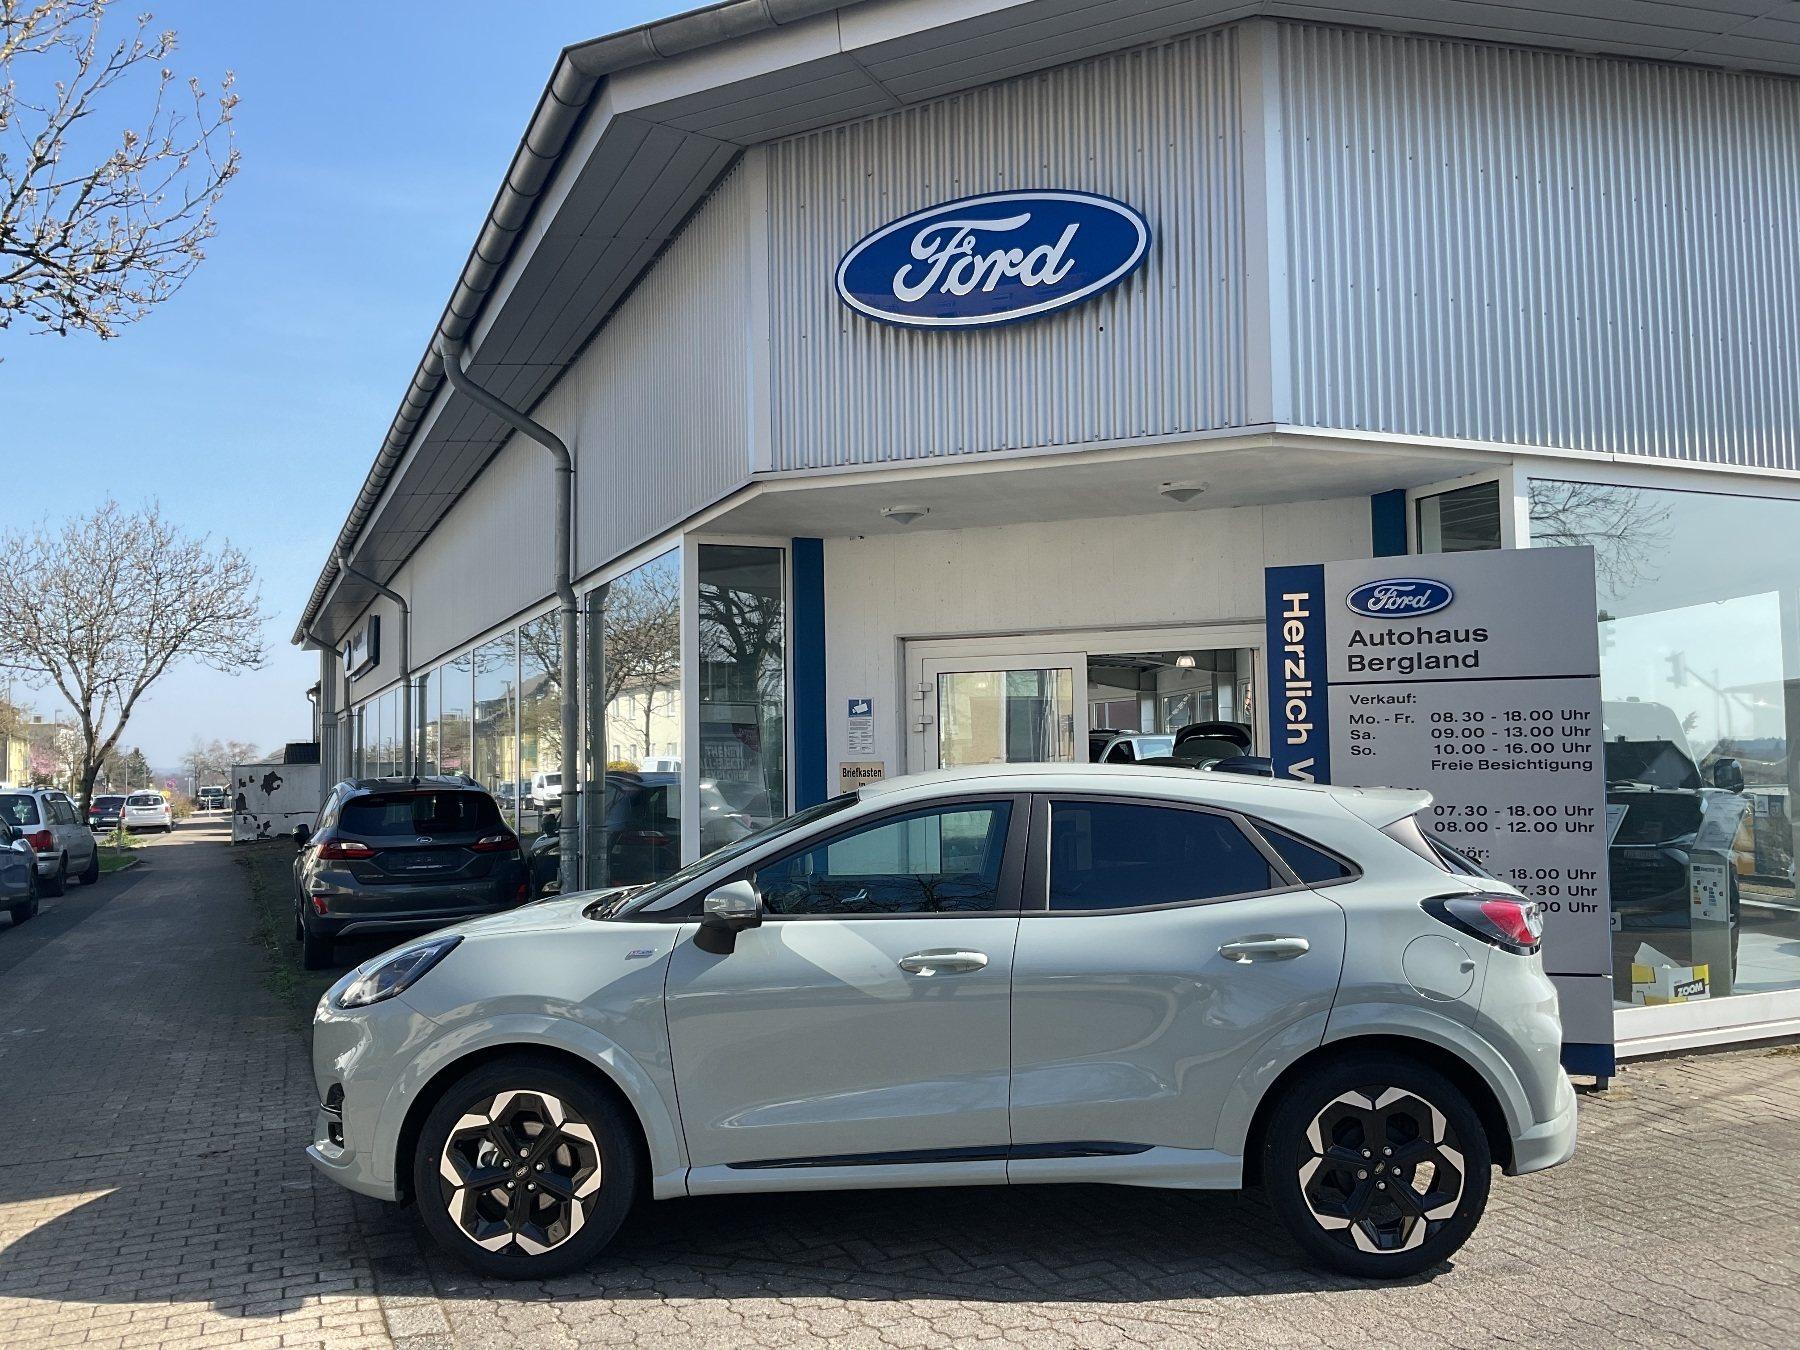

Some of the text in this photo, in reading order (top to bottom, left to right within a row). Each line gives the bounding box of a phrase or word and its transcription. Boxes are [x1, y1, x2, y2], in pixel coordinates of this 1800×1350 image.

[893, 213, 1080, 302] Ford
[1367, 584, 1432, 611] Ford
[1347, 627, 1488, 648] Autohaus
[1282, 592, 1313, 745] Herzlich
[1347, 649, 1480, 675] Bergland
[1349, 693, 1417, 705] Verkauf:
[1349, 713, 1380, 725] Mo.
[1394, 713, 1415, 724] Fr.
[1503, 710, 1554, 721] 18.00
[1561, 709, 1591, 720] Uhr
[1350, 729, 1376, 740] Sa.
[1431, 727, 1485, 738] 09.00
[1504, 726, 1554, 738] 13.00
[1561, 726, 1591, 737] Uhr
[1350, 745, 1376, 756] So.
[1434, 743, 1485, 755] 10.00
[1504, 742, 1555, 754] 16.00
[1562, 742, 1592, 753] Uhr
[842, 767, 882, 777] Briefkasten
[1431, 759, 1593, 772] Freie Besichtigung
[1433, 805, 1488, 817] 07.30
[1506, 805, 1557, 817] 18.00
[1564, 805, 1594, 816] Uhr
[1434, 821, 1488, 833] 08.00
[1507, 821, 1558, 833] 12.00
[1565, 821, 1595, 833] Uhr
[1509, 868, 1560, 880] 18.00
[1567, 868, 1597, 880] Uhr
[1513, 884, 1597, 896] 7.30 Uhr
[1568, 901, 1598, 913] Uhr
[1677, 981, 1704, 997] ZOOM
